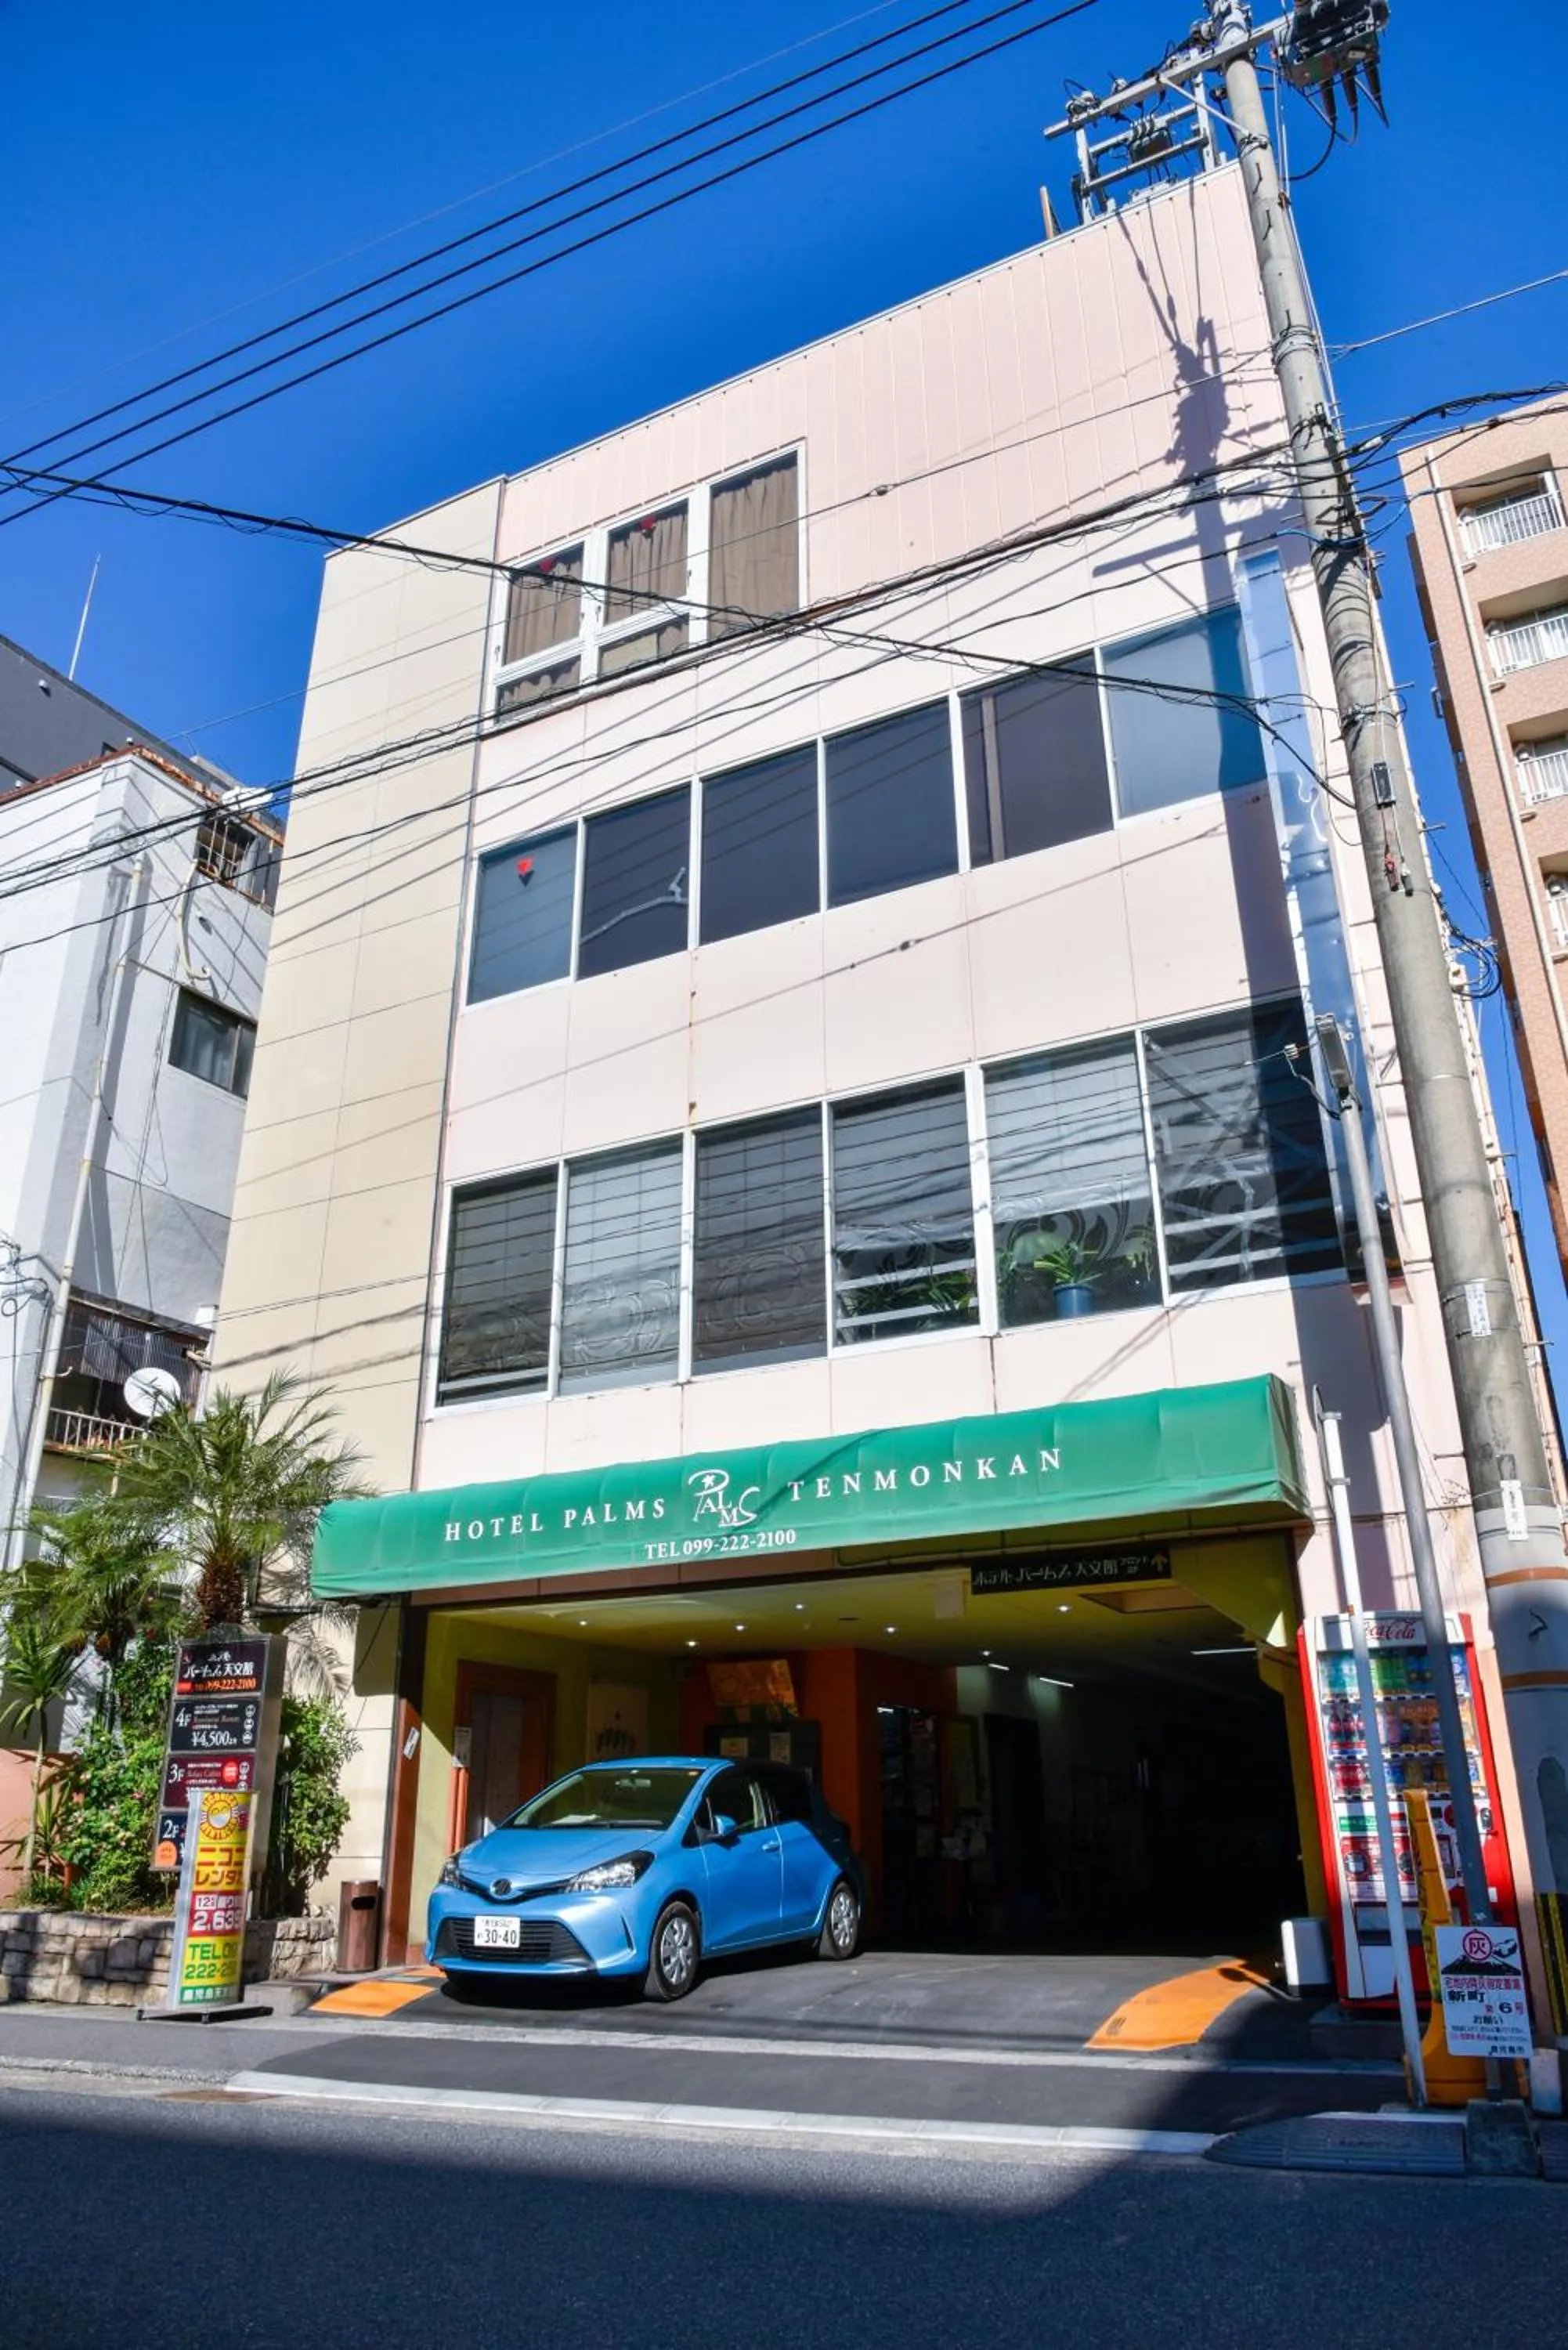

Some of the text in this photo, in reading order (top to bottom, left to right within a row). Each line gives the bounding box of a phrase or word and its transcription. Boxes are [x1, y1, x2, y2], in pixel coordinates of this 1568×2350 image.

[788, 1448, 1060, 1502] TENMONKAN
[445, 1499, 665, 1542] HOTEL PALMS
[683, 1529, 797, 1555] 099-222-2100
[1366, 1617, 1416, 1640] oca-Cola
[175, 1707, 192, 1728] 4F
[168, 1763, 186, 1784] 3F
[162, 1820, 179, 1838] 2F
[1469, 1937, 1487, 1955] 灰
[1447, 1990, 1486, 2003] 新町
[1499, 2002, 1512, 2013] 6
